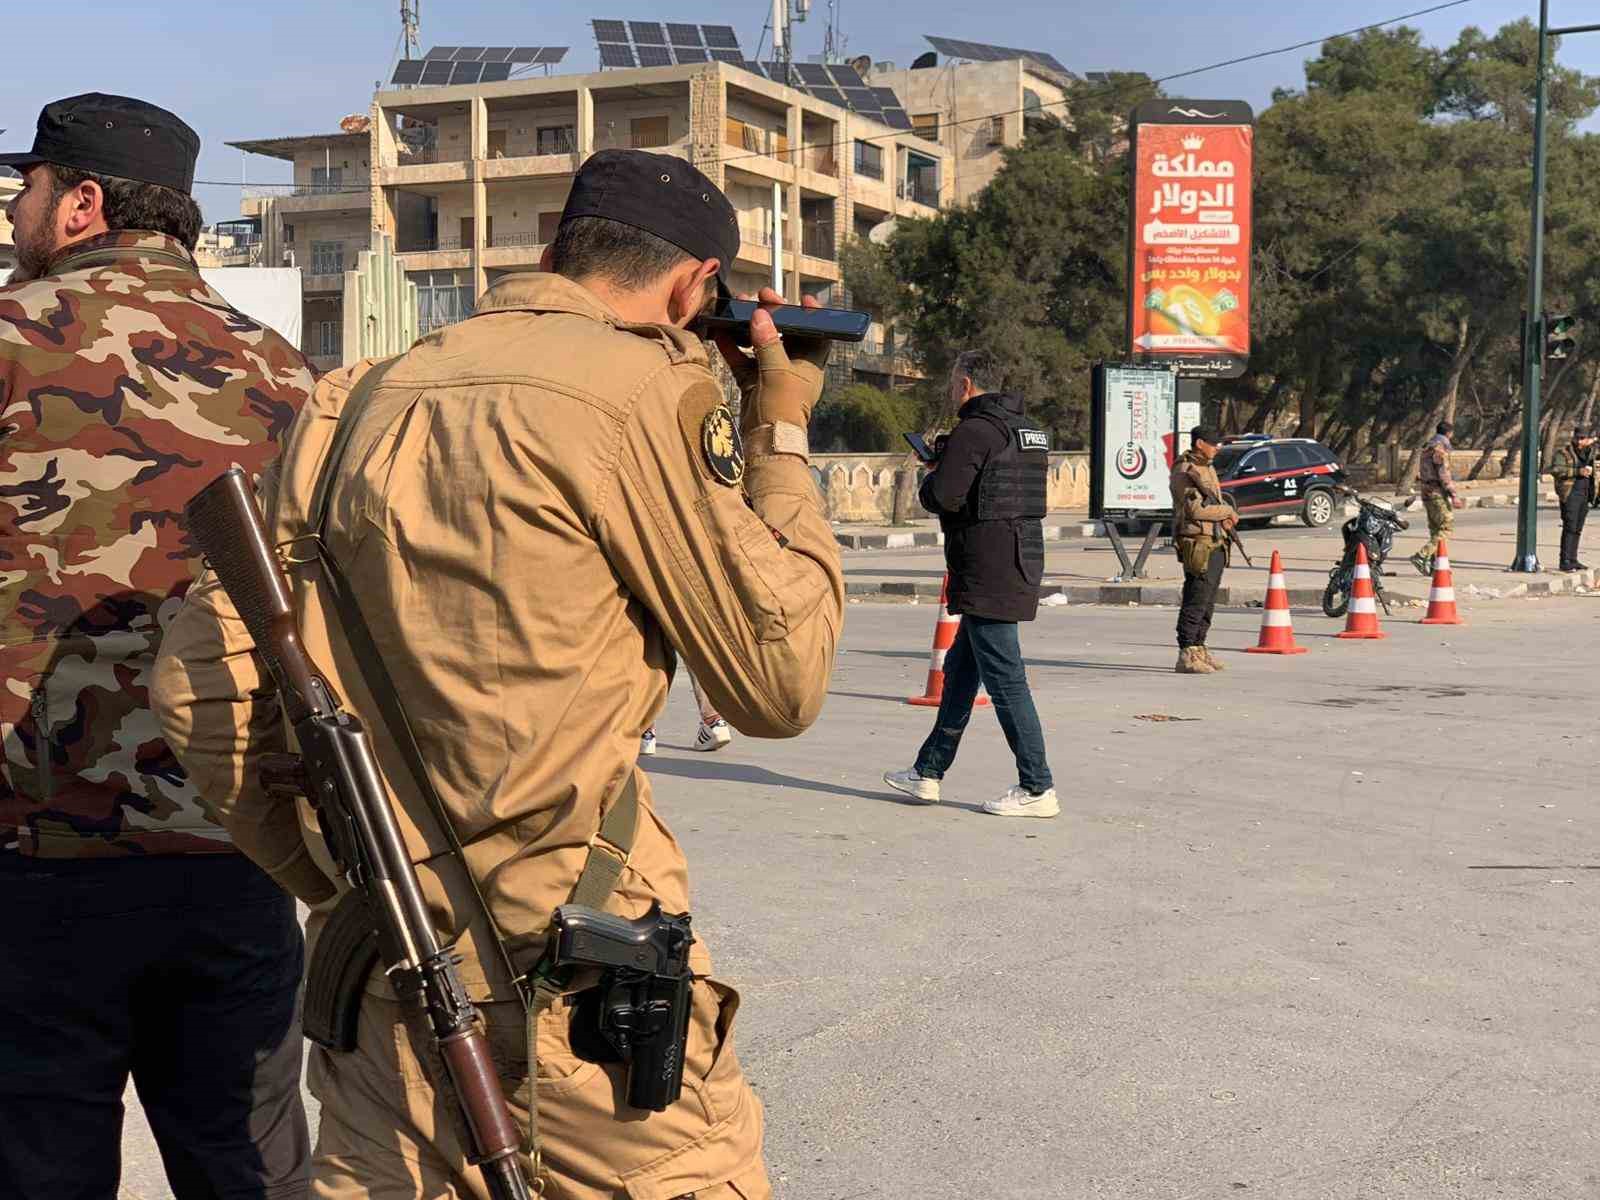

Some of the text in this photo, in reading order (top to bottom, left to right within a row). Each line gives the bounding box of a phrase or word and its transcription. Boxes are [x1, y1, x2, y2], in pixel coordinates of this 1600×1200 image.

[1152, 153, 1234, 177] مملكة
[1150, 183, 1234, 214] الدولار
[1169, 266, 1200, 282] واحد
[1202, 266, 1242, 283] بدولار
[1024, 433, 1047, 445] PRESS
